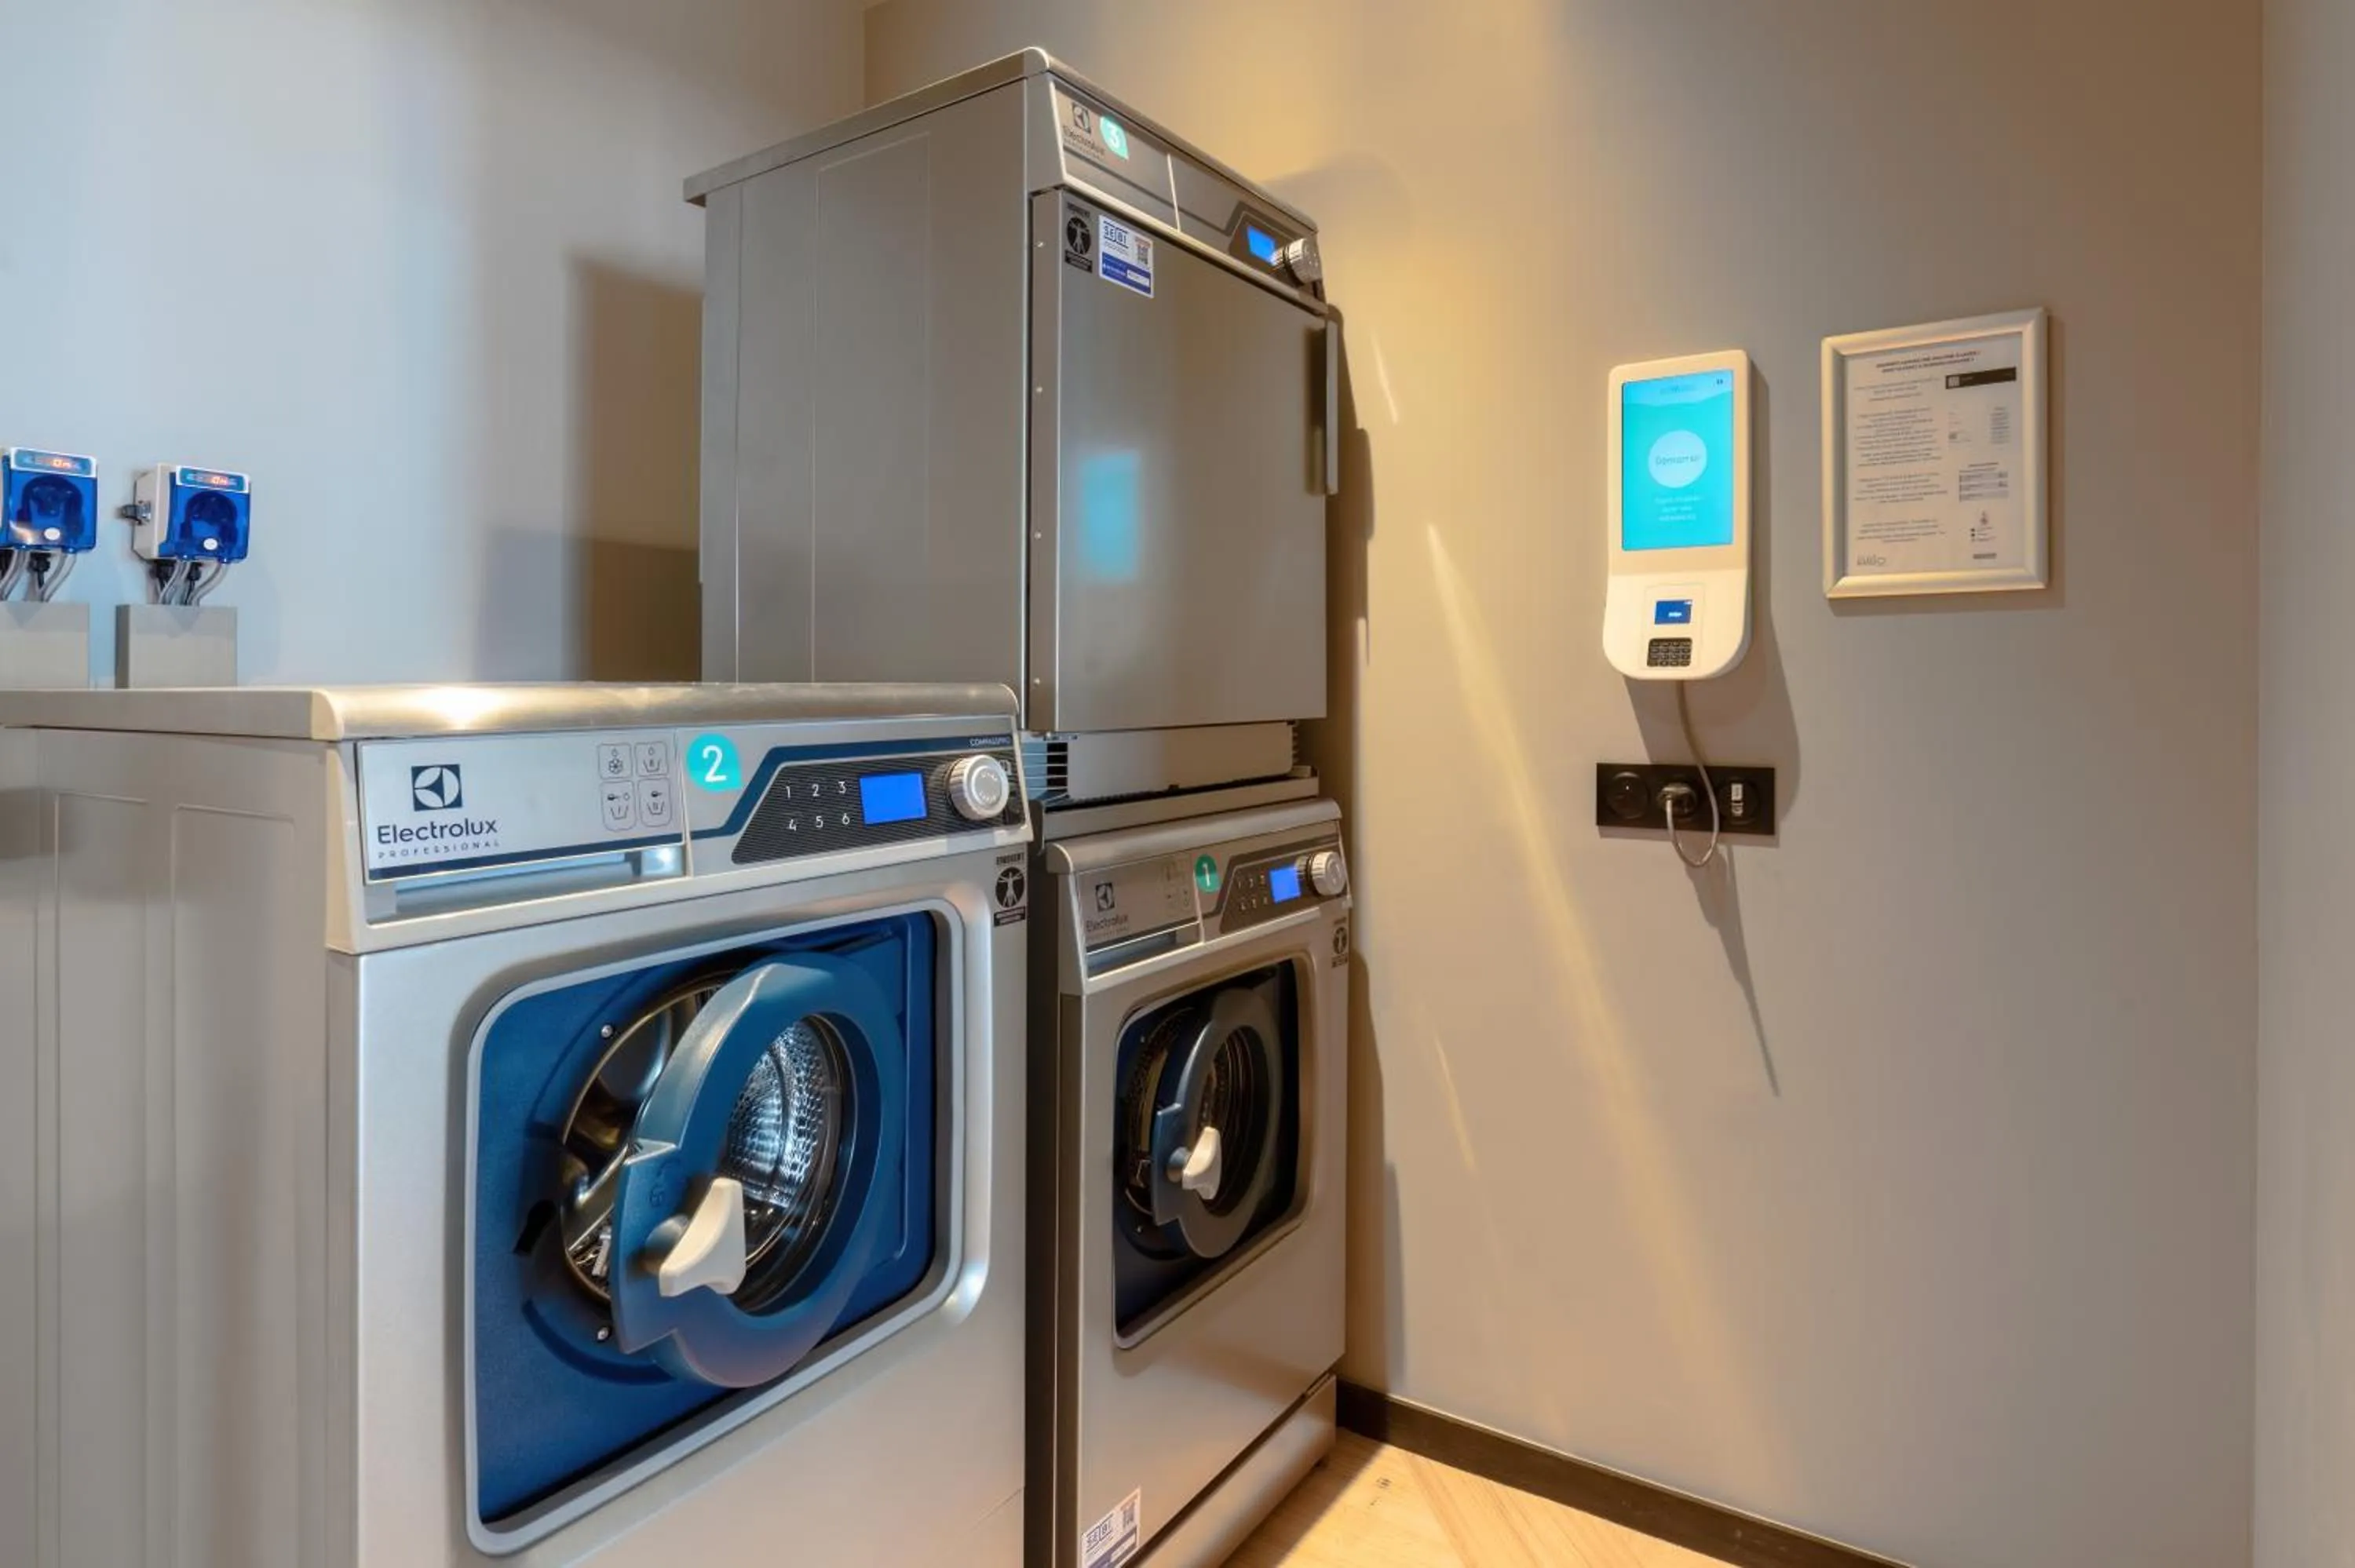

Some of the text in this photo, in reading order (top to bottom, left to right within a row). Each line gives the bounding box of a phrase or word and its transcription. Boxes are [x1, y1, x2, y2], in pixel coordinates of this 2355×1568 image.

[1107, 123, 1120, 149] 3
[702, 744, 728, 782] 2
[786, 780, 847, 798] 1 2 3
[377, 817, 498, 844] Electrolux
[788, 812, 850, 831] 4 5 6
[378, 840, 501, 859] PROFESSIONAL
[1202, 862, 1211, 888] 1
